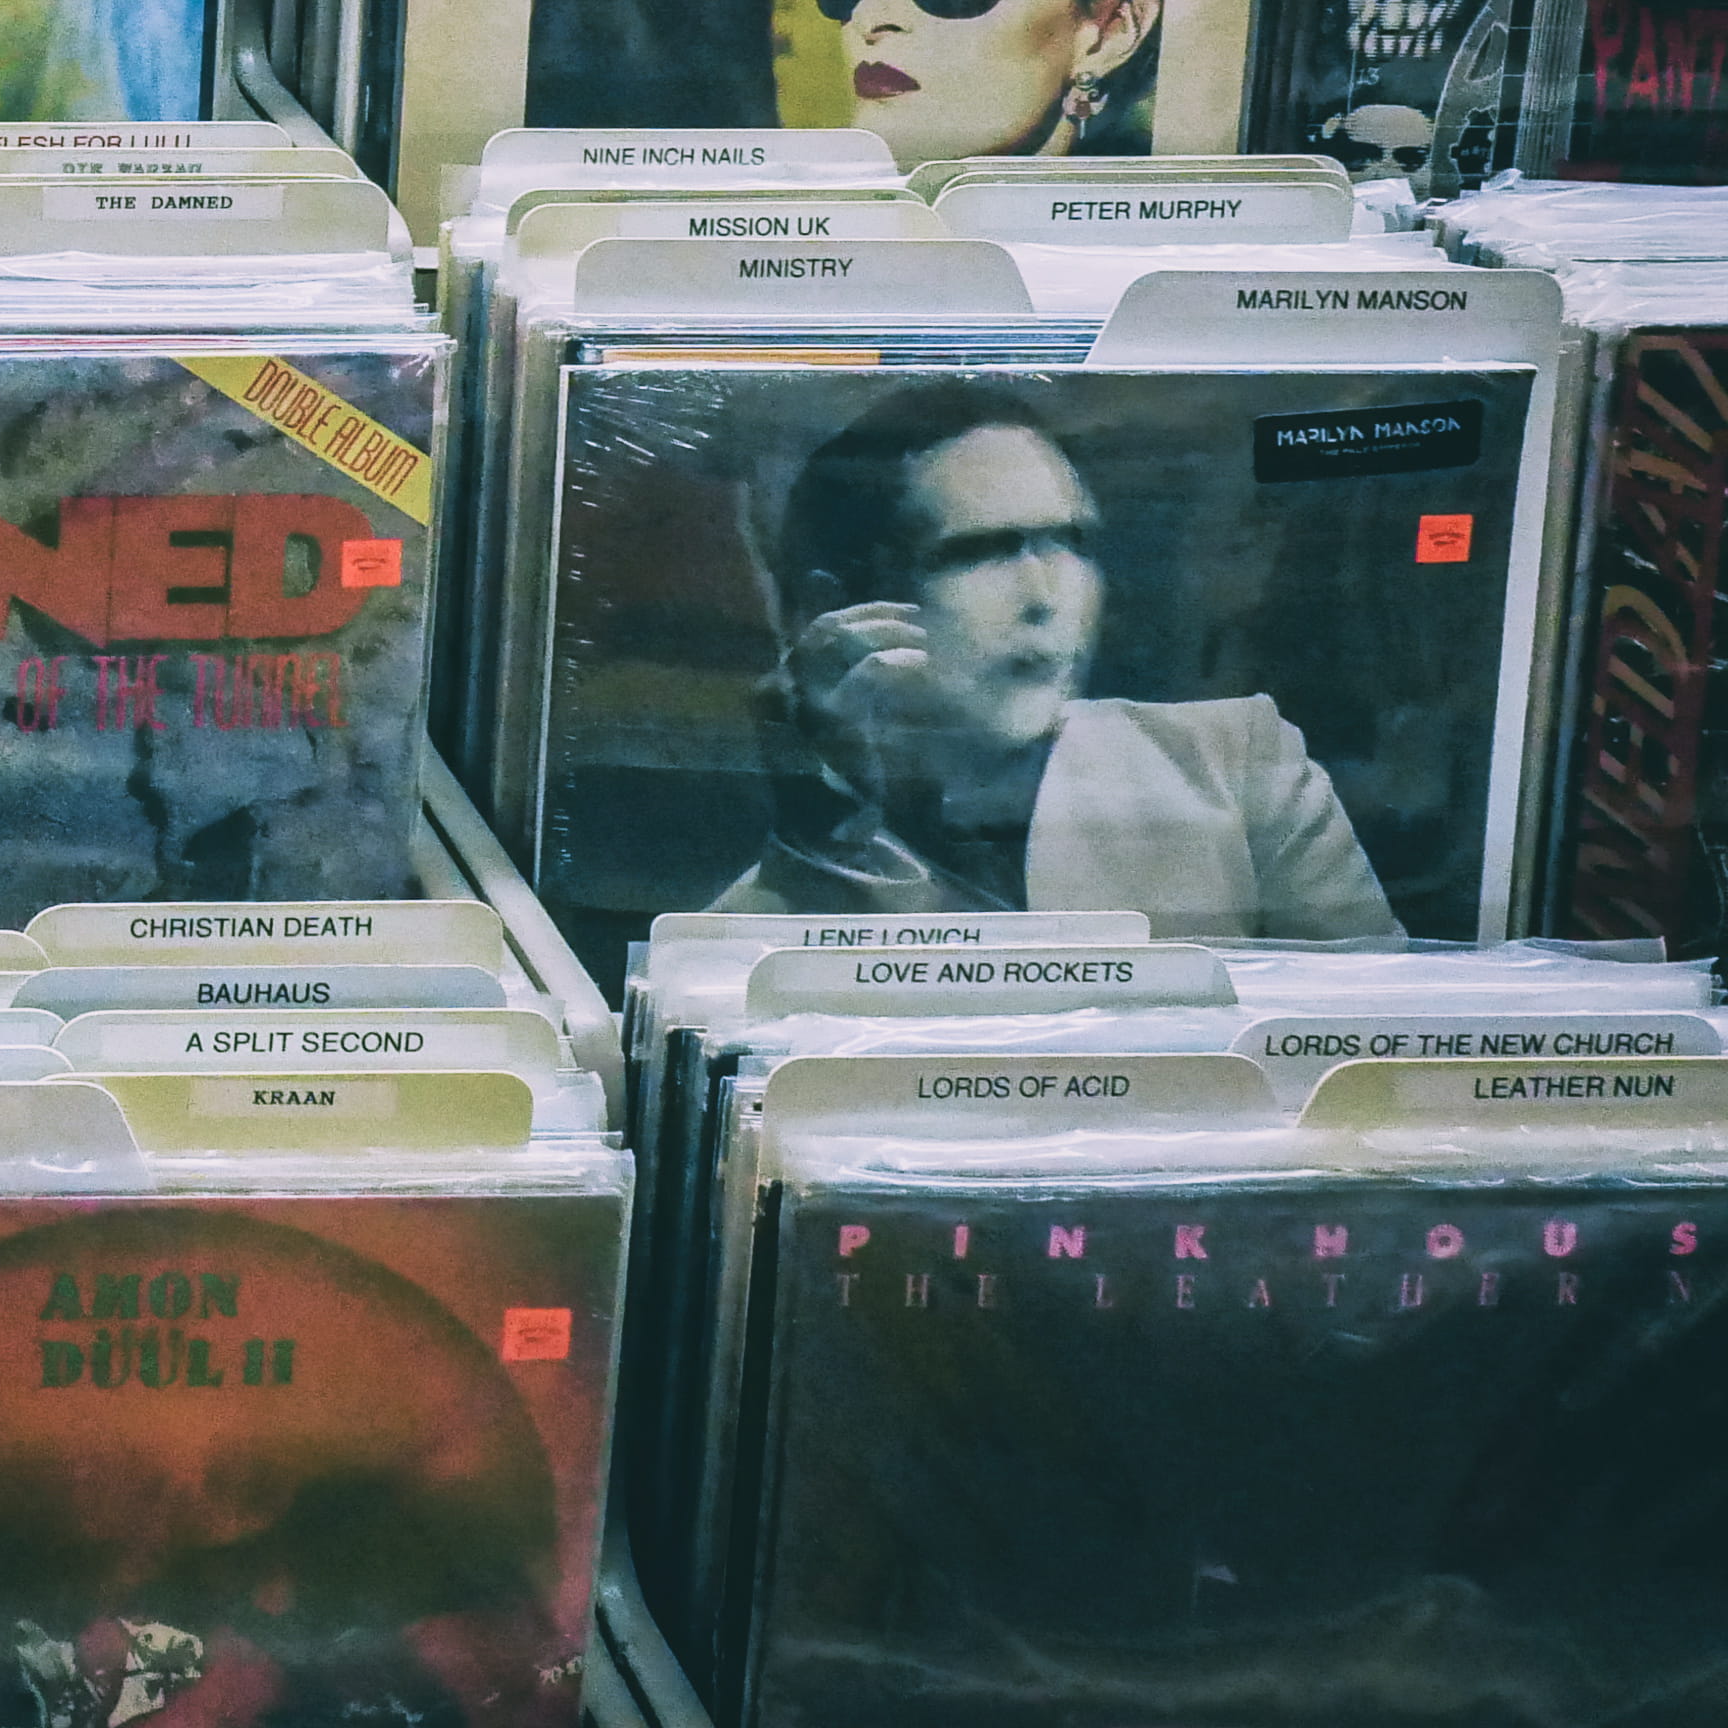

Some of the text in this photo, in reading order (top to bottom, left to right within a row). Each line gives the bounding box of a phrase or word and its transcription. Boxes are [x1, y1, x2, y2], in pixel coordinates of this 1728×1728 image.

[583, 147, 765, 166] NINE INCH NAILS
[95, 196, 234, 210] THE DAMNED
[1051, 199, 1242, 221] PETER MURPHY
[689, 216, 831, 237] MISSION UK
[739, 257, 854, 279] MINISTRY
[1236, 289, 1468, 311] MARILYN MANSON
[239, 359, 419, 499] DOUBLE ALBUM
[1276, 425, 1365, 447] MARILYN
[130, 916, 373, 939] CHRISTIAN DEATH
[802, 928, 981, 947] LENE LOVICH
[855, 961, 1134, 984] LOVE AND ROCKETS
[197, 982, 330, 1005] BAUHAUS
[185, 1031, 424, 1053] A SPLIT SECOND
[1265, 1032, 1675, 1057] LORDS OF THE NEW CHURCH
[252, 1090, 336, 1106] KRAAN
[917, 1075, 1131, 1100] LORDS OF ACID
[1473, 1074, 1676, 1100] LEATHER NUN
[837, 1222, 1700, 1261] PINK HOUS
[41, 1272, 241, 1322] AMON
[244, 1340, 296, 1387] II
